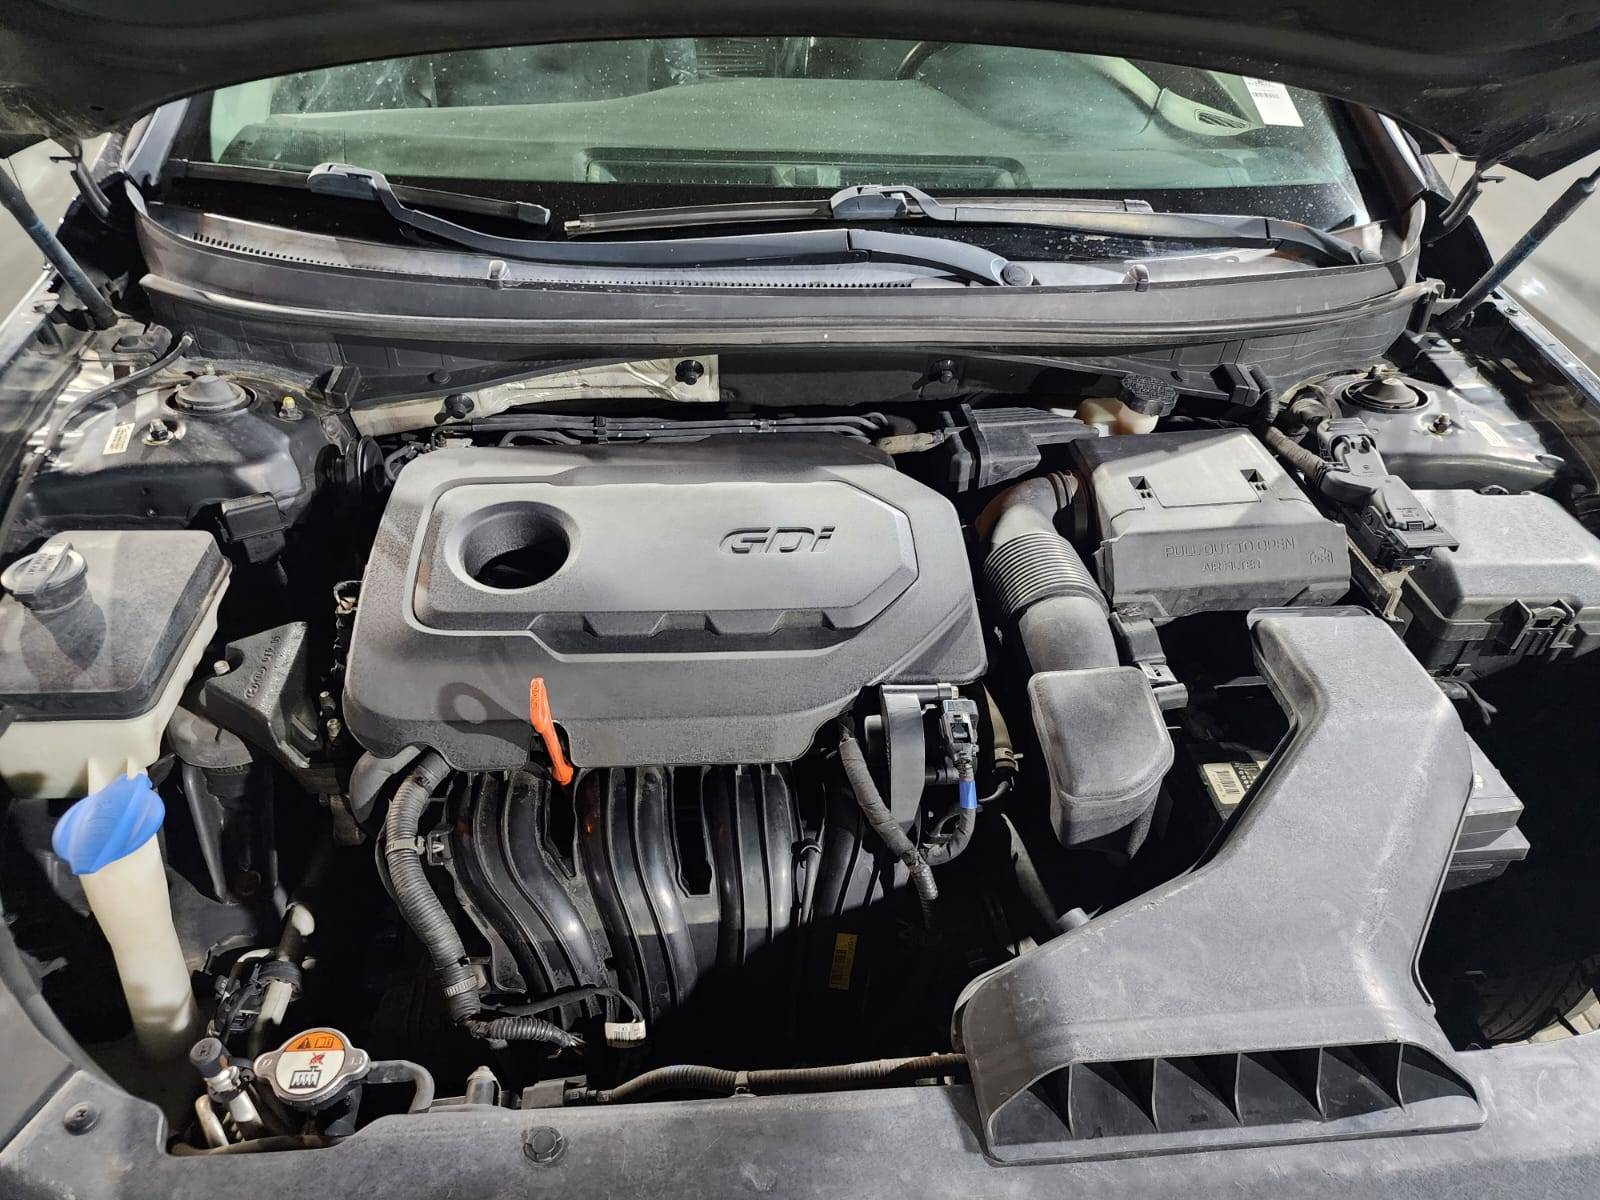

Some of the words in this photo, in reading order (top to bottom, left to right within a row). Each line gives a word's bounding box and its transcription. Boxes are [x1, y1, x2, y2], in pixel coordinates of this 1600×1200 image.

[1165, 544, 1200, 558] PULL
[1204, 541, 1232, 556] OUT
[1237, 541, 1255, 554] TO
[1257, 537, 1296, 551] OPEN
